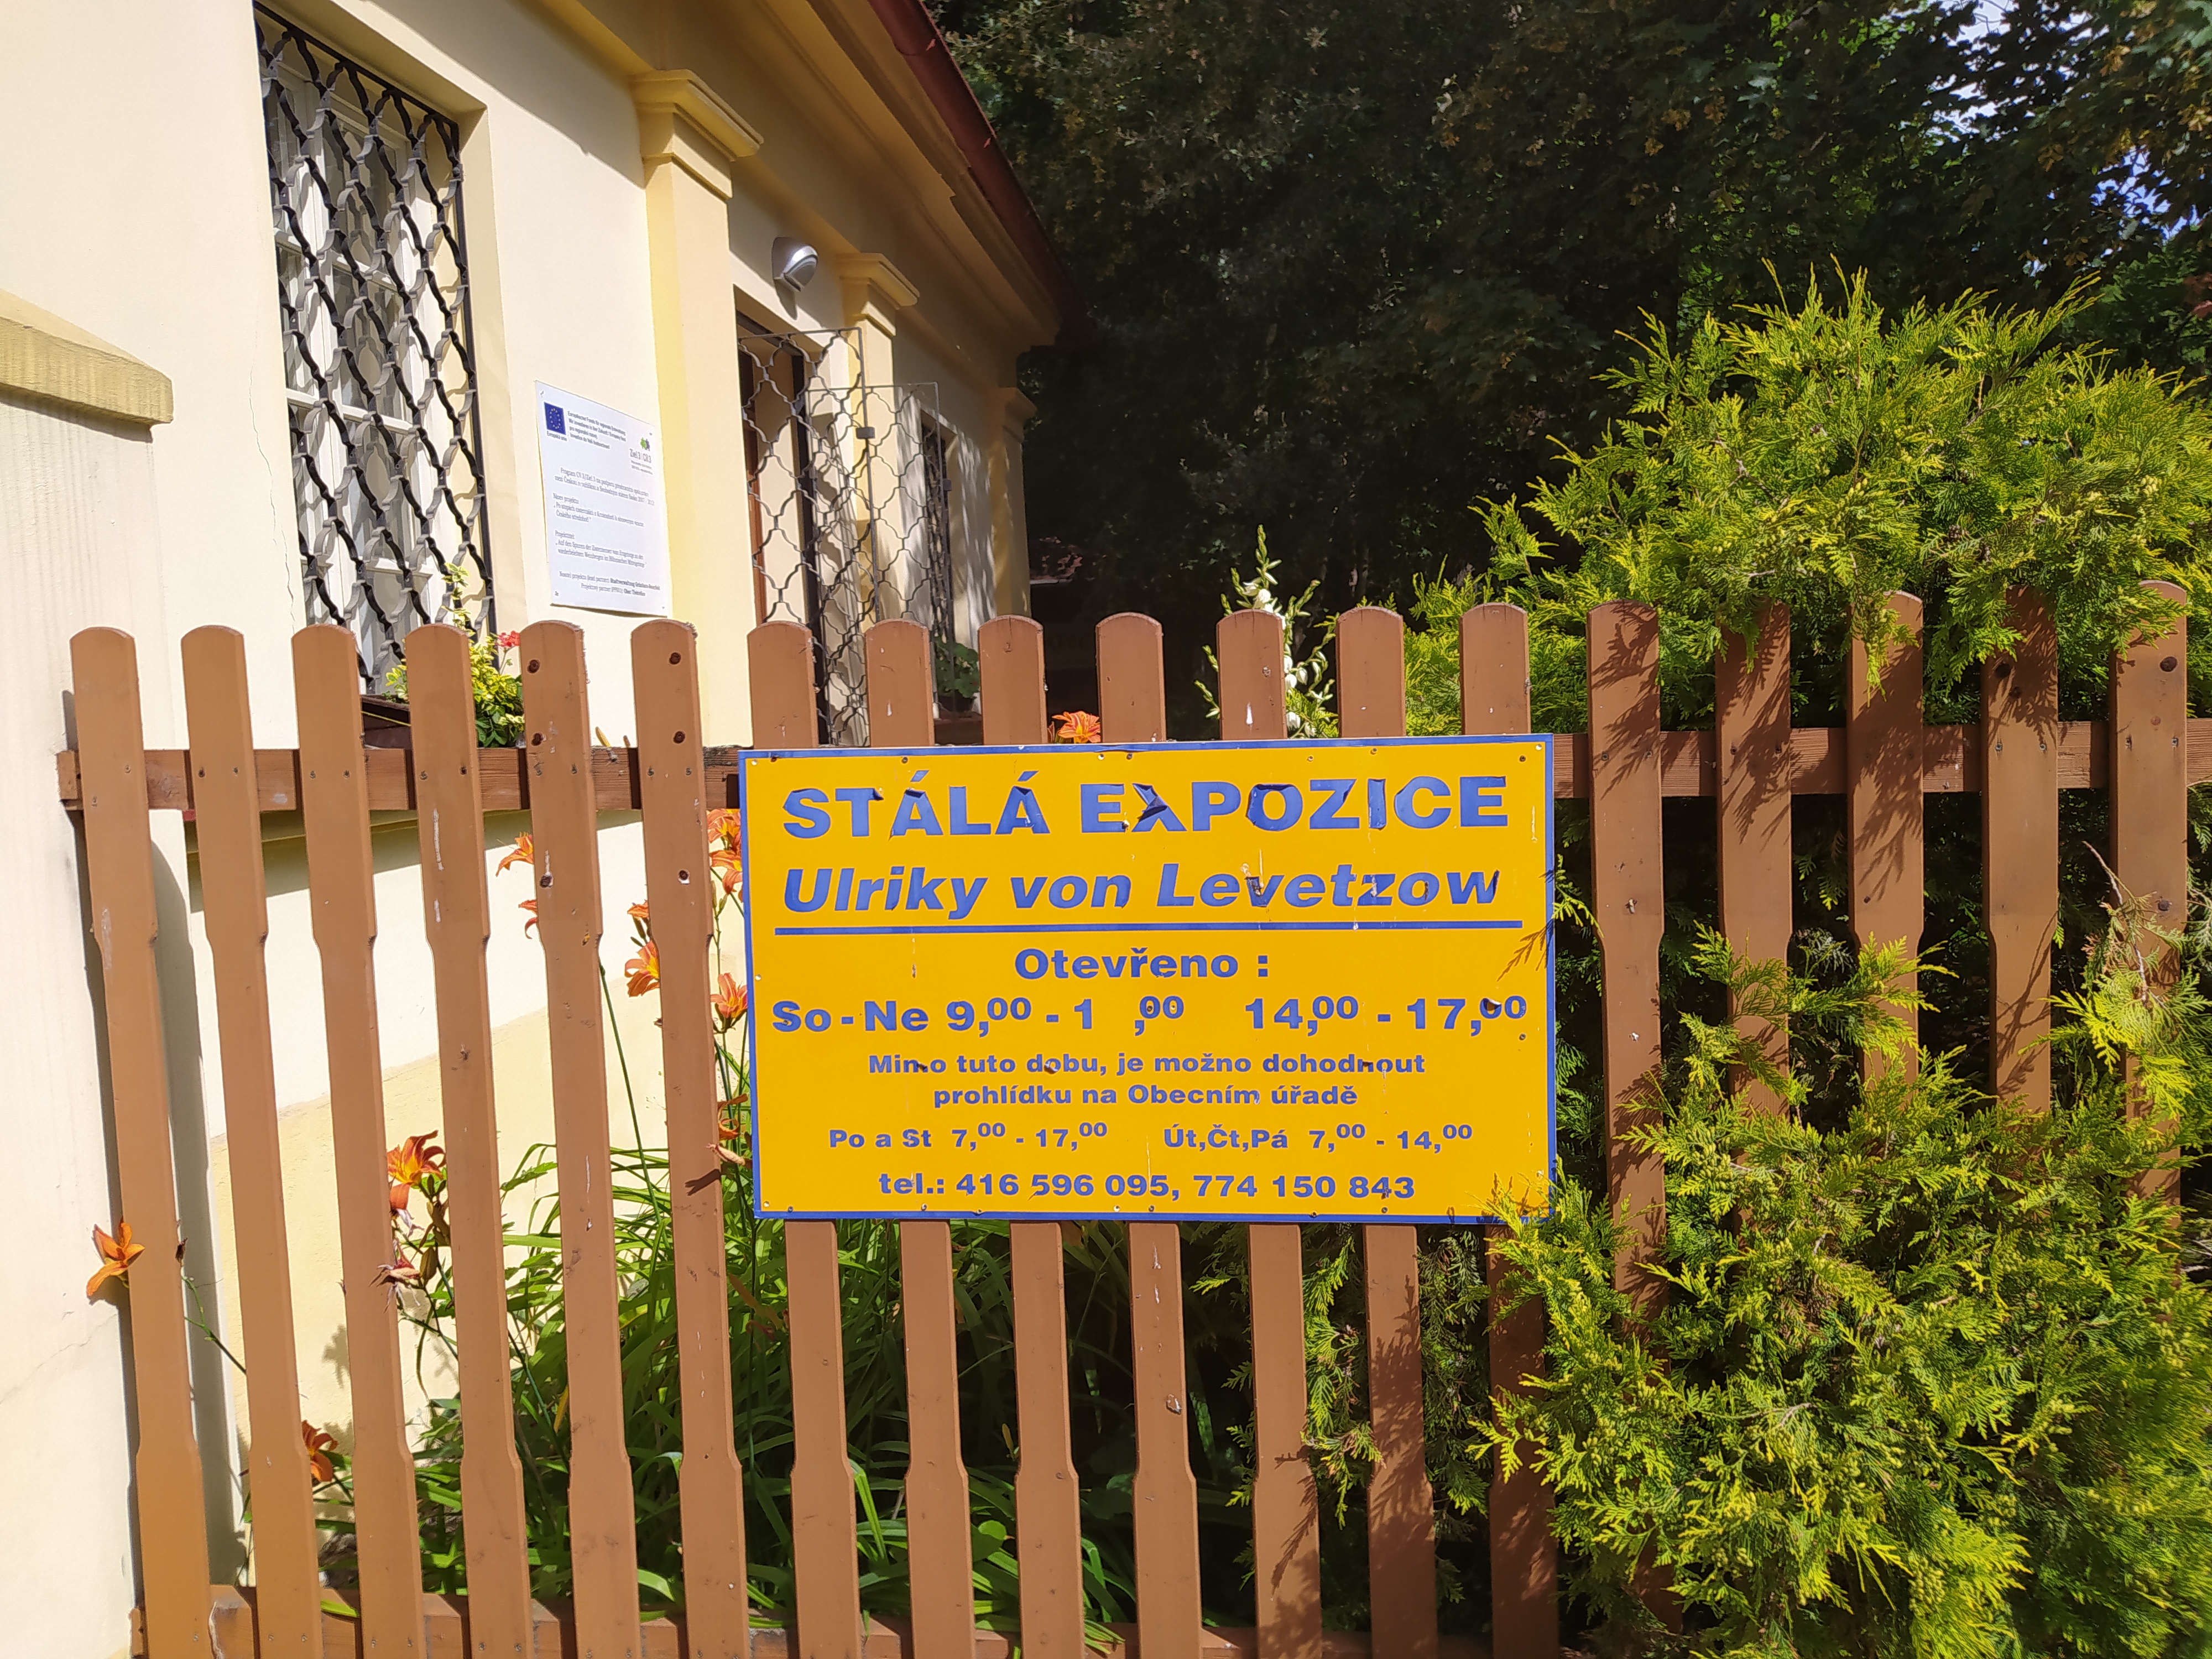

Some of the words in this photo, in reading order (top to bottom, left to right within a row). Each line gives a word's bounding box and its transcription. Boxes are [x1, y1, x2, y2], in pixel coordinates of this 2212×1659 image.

[784, 770, 1050, 839] STÁLÁ
[1080, 776, 1508, 833] EXPOZICE
[784, 866, 988, 920] Ulriky
[1010, 875, 1131, 909] von
[1156, 863, 1500, 908] Levetzow
[1015, 947, 1238, 980] Otevřeno
[946, 997, 1032, 1037] 9,00
[1245, 996, 1359, 1036] 14,00
[1407, 995, 1527, 1036] 17,00
[957, 1055, 1016, 1073] tuto
[1026, 1054, 1106, 1076] dobu,
[1116, 1054, 1143, 1076] je
[1155, 1053, 1250, 1073] možno
[1263, 1053, 1425, 1073] dohodnout
[935, 1086, 1072, 1108] prohlídku
[1082, 1090, 1117, 1104] na
[1128, 1084, 1260, 1104] Obecním
[1271, 1086, 1358, 1105] úřadě
[830, 1129, 864, 1148] Po
[875, 1134, 892, 1148] a
[902, 1129, 931, 1148] St
[951, 1123, 1005, 1150] 7,00
[1035, 1123, 1108, 1151] 17,00
[1309, 1124, 1366, 1152] 7,00
[1397, 1124, 1473, 1153] 14,00
[878, 1173, 945, 1194] tel.:
[956, 1174, 1019, 1196] 416
[1031, 1175, 1094, 1196] 596
[1105, 1175, 1179, 1201] 095,
[1193, 1175, 1258, 1197] 774
[1272, 1176, 1336, 1198] 150
[1349, 1176, 1415, 1199] 843
